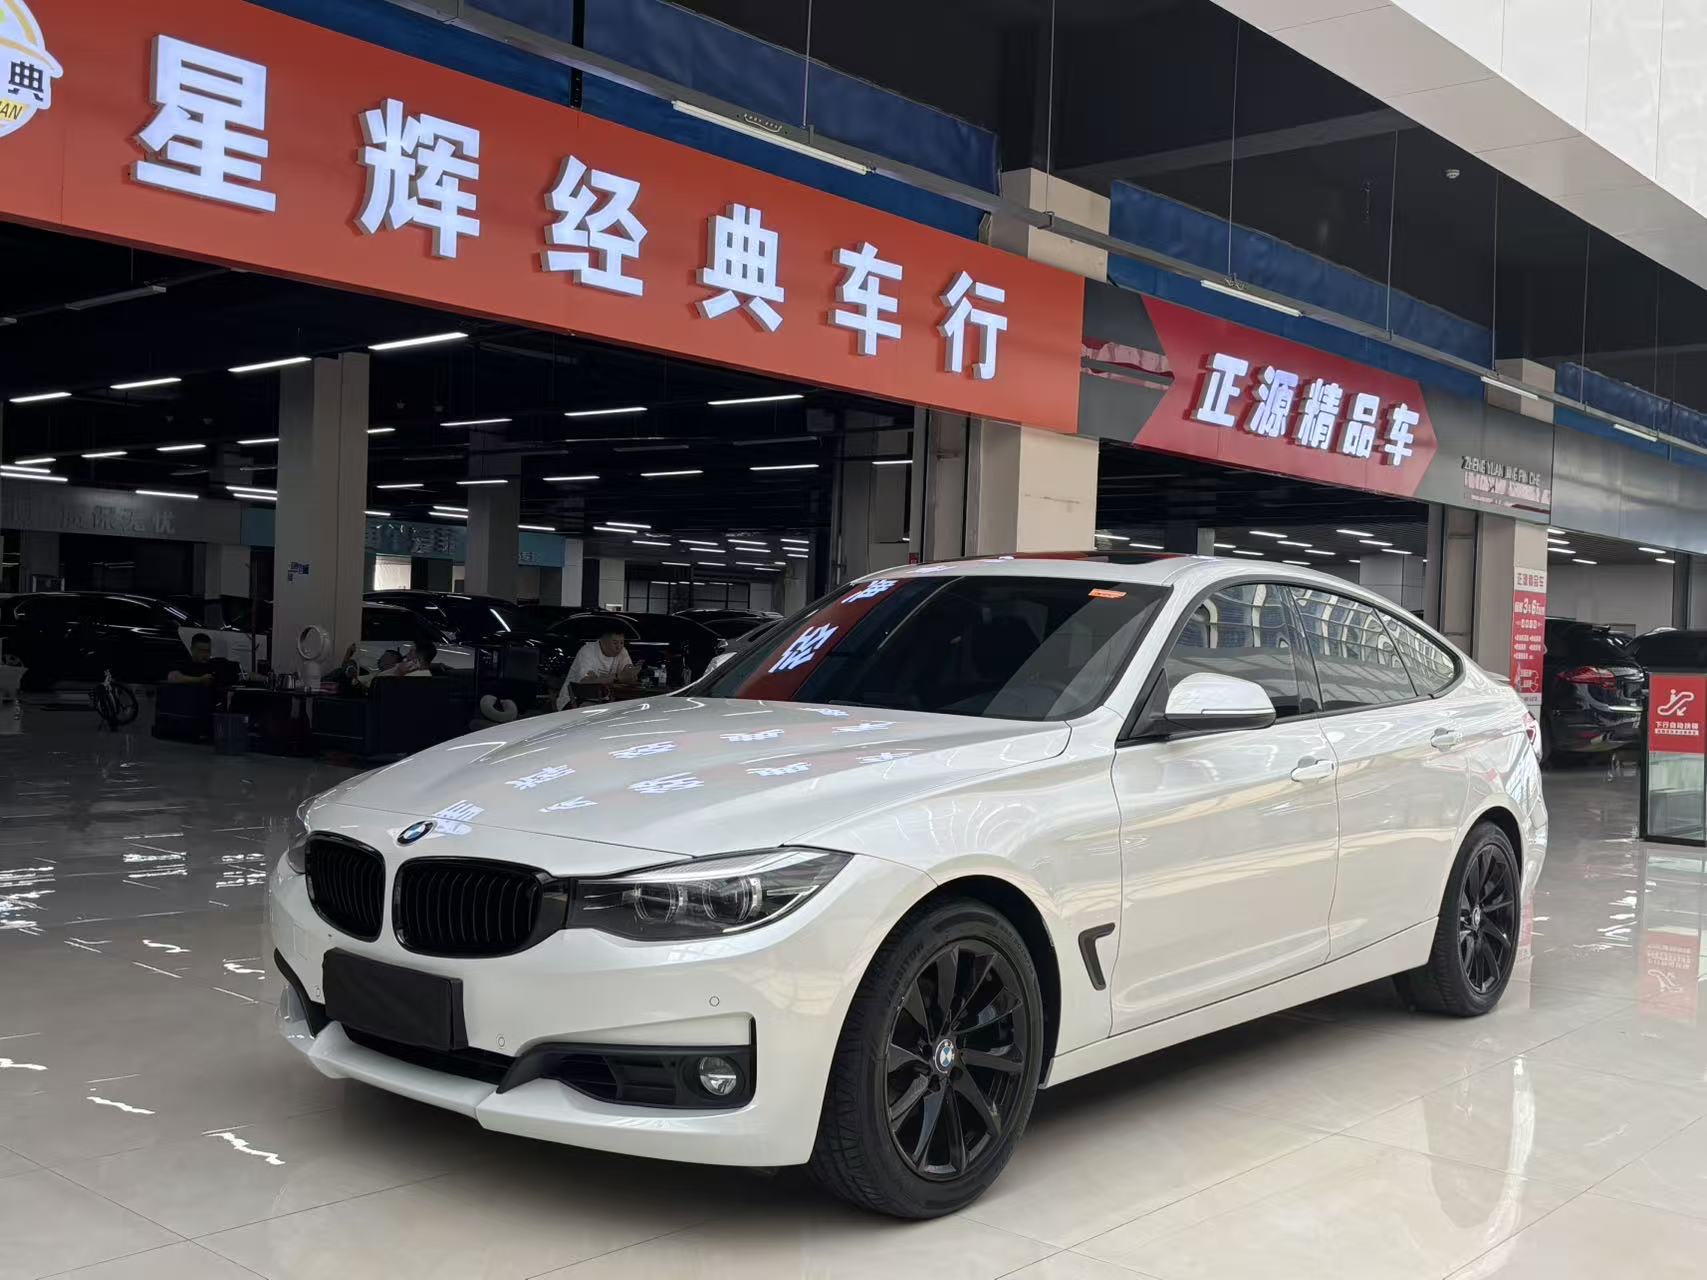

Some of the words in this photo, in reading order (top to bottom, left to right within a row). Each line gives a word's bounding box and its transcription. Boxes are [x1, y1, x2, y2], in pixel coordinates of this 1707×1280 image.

[0, 101, 23, 120] AN
[8, 61, 44, 102] 典
[131, 34, 1007, 380] 星辉经典车行
[1192, 353, 1420, 466] 正源精品车
